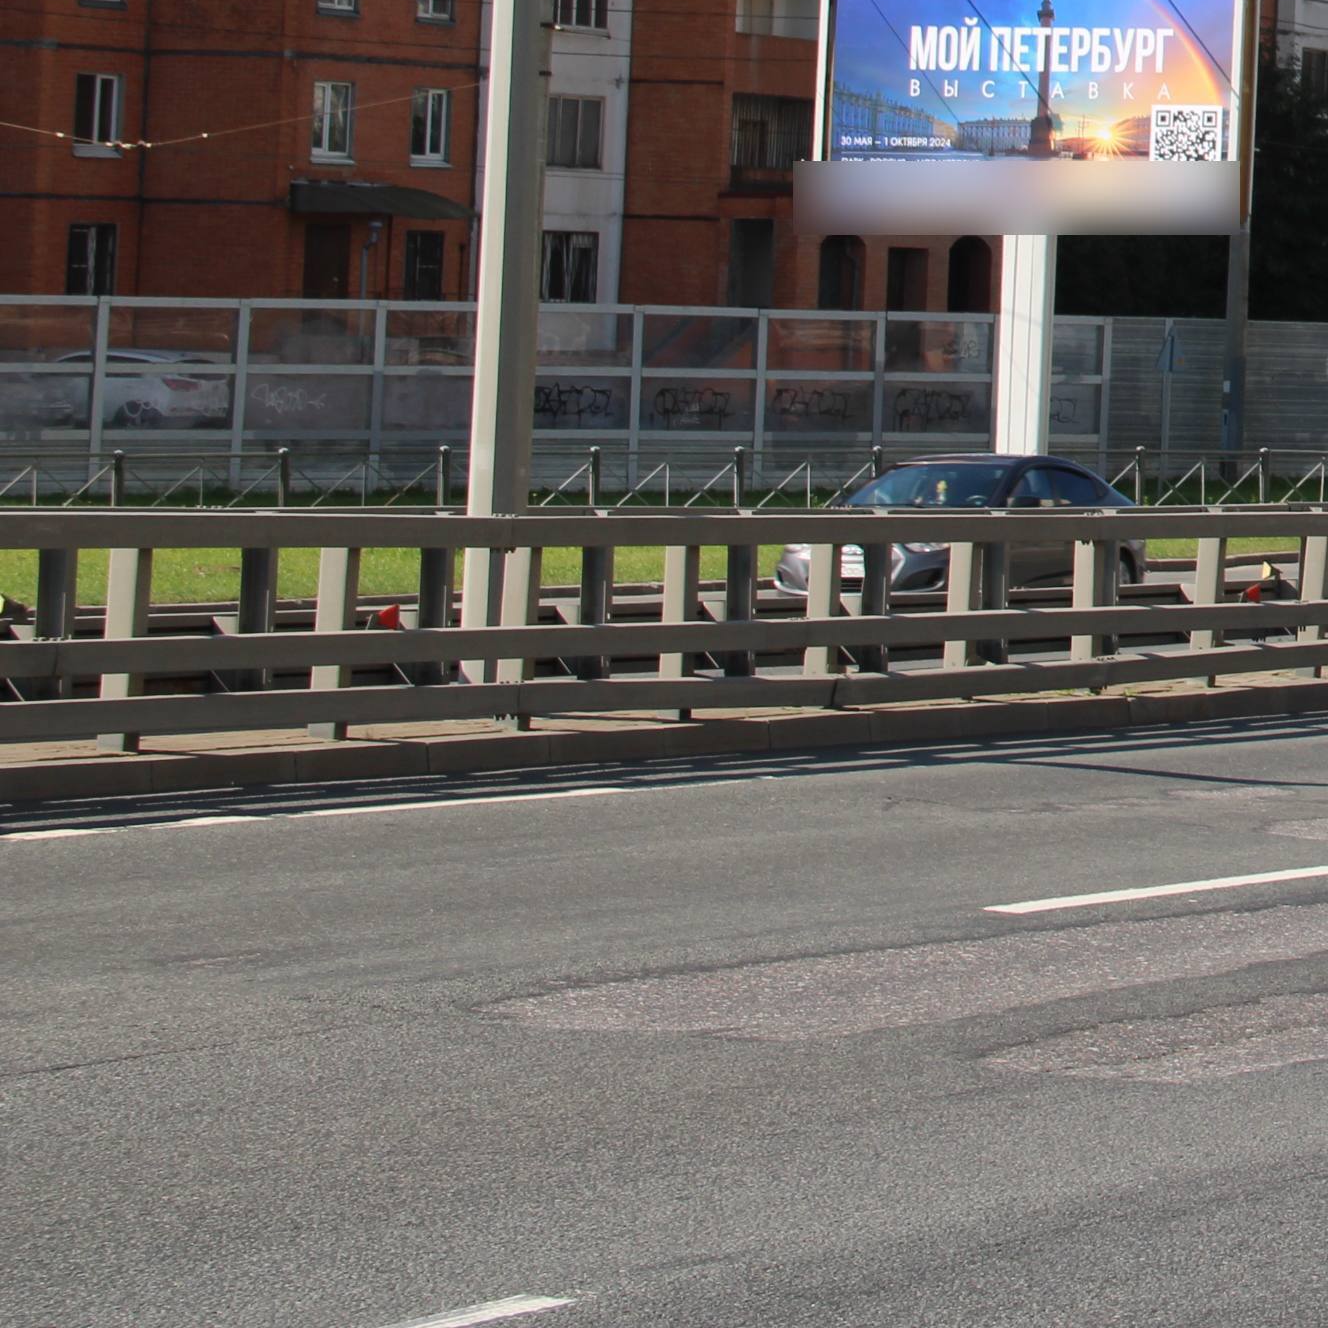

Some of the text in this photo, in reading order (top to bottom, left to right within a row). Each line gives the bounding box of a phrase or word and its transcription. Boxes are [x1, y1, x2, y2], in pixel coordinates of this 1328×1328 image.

[909, 17, 1174, 73] МОЙ ПЕТЕРБУРГ
[909, 78, 1172, 101] ВЫСТАВКА
[840, 136, 852, 146] 30
[853, 136, 873, 146] МАЯ
[890, 137, 928, 147] ОКТЯБРЯ
[929, 137, 951, 148] 2024
